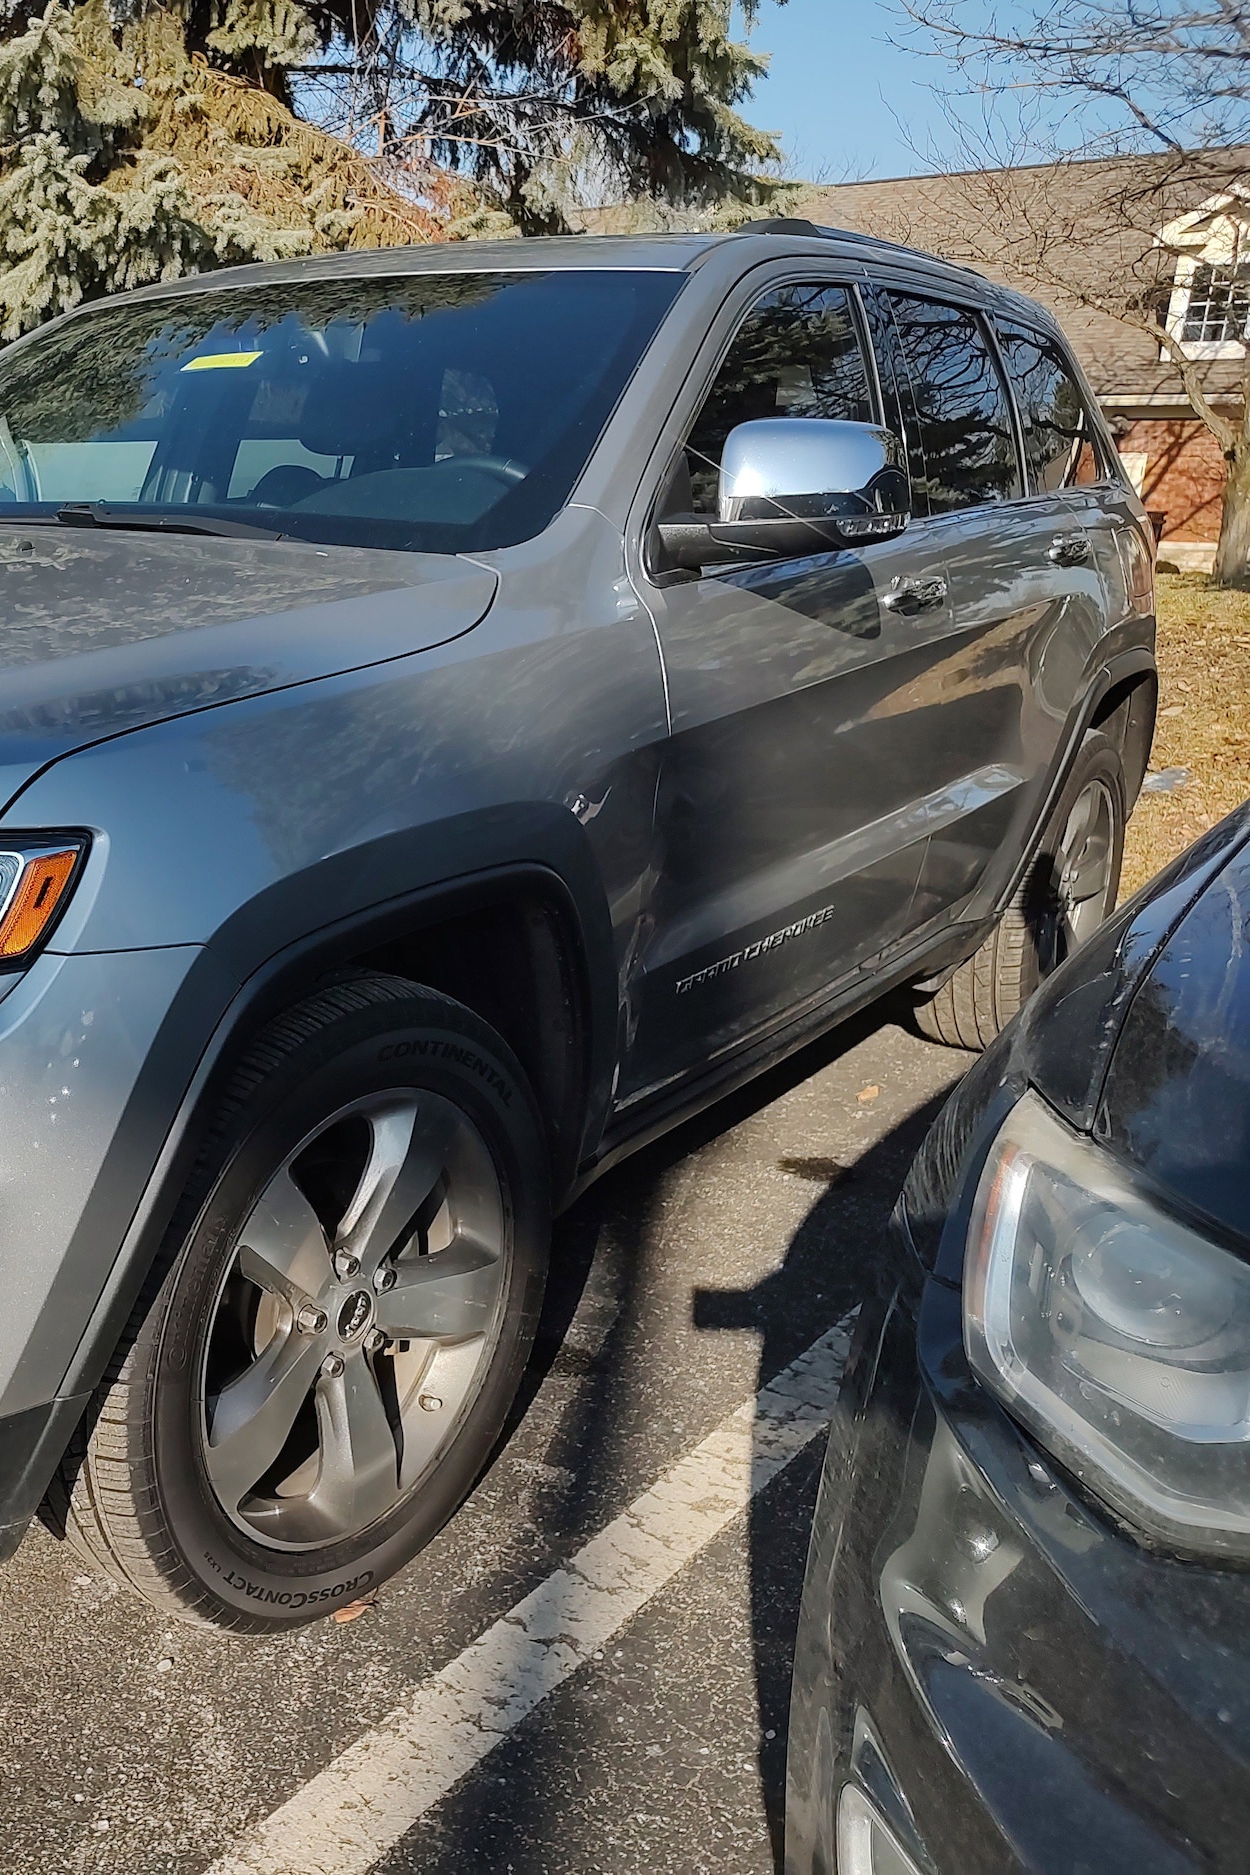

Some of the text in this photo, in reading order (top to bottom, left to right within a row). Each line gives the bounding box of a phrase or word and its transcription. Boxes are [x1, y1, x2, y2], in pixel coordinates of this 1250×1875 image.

[675, 904, 835, 995] GRAND CHEROKEE
[377, 1040, 513, 1108] CONTINENTAL
